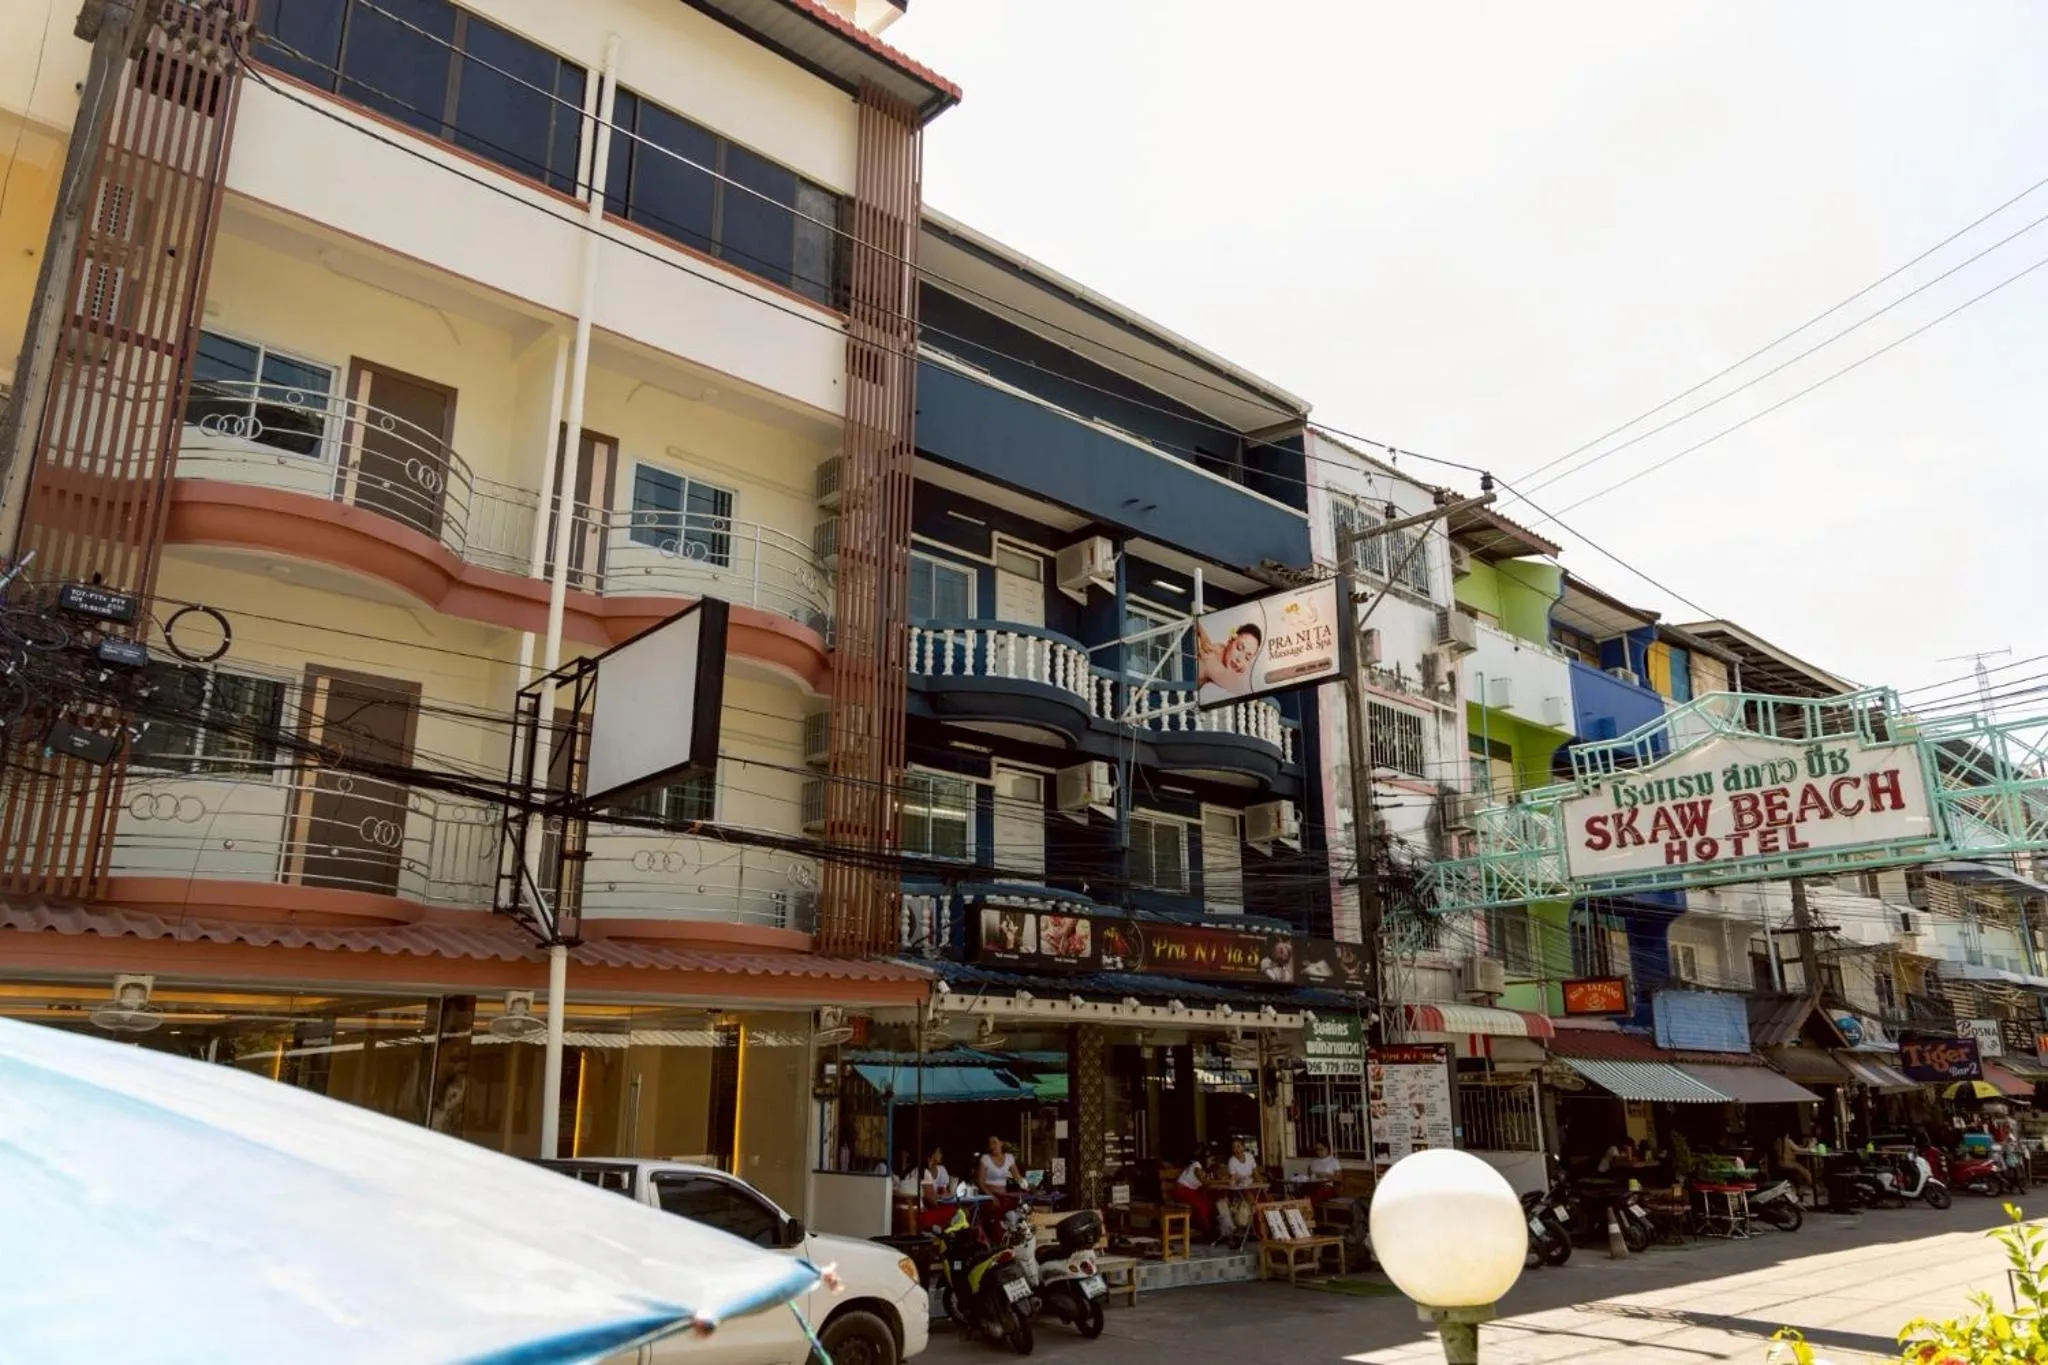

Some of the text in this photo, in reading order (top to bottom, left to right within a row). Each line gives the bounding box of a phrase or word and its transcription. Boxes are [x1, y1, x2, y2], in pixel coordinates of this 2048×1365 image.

[1268, 634, 1293, 651] PRA
[1269, 638, 1332, 660] Massage & Spa
[1583, 769, 1906, 852] SKAW BEACH
[1664, 825, 1809, 865] HOTEL
[1902, 1041, 1970, 1072] Tiger
[1969, 1062, 1979, 1075] 2
